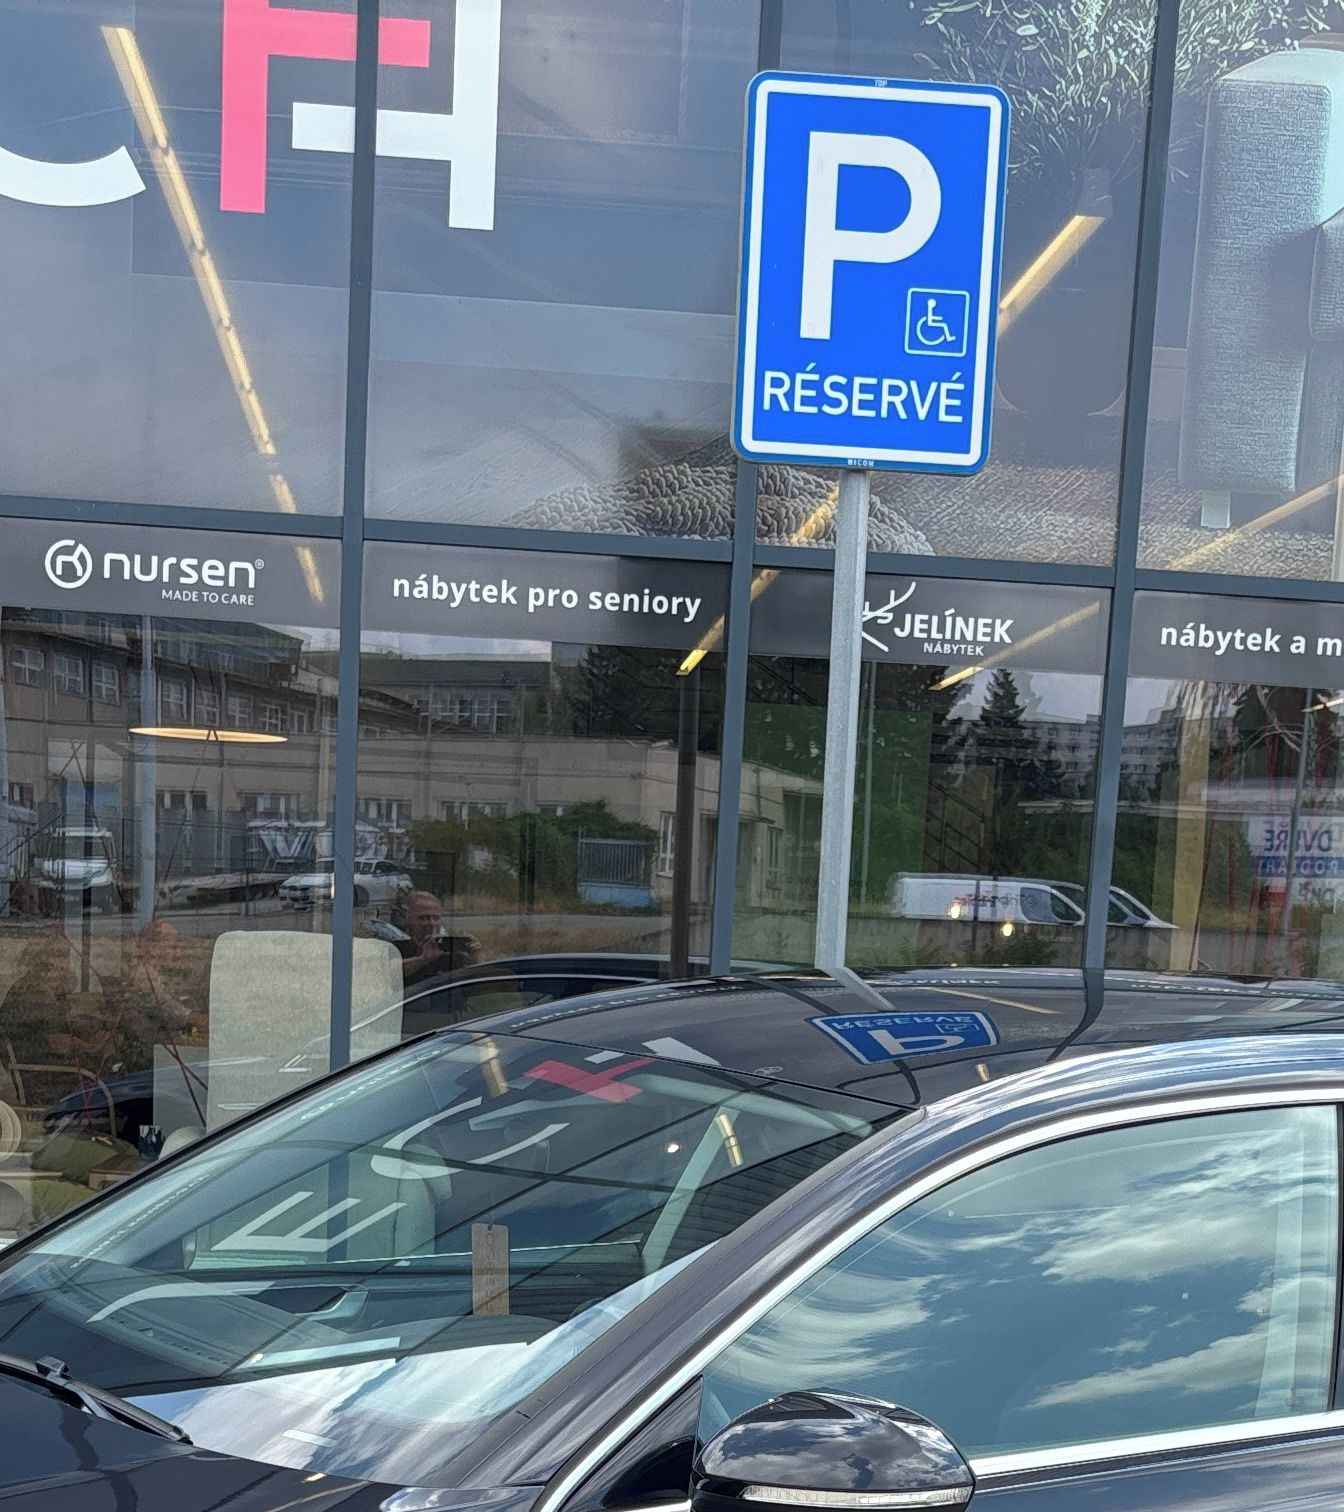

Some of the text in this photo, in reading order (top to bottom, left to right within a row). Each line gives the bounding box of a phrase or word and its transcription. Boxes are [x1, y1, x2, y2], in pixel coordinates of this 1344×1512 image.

[800, 132, 941, 339] P
[763, 364, 964, 423] RÉSERVÉ
[161, 588, 255, 606] MADE TO CARE
[393, 573, 702, 623] nábytek pro seniory
[893, 606, 1014, 645] JELÍNEK
[1160, 622, 1281, 656] nábytek
[1290, 635, 1306, 654] a
[922, 640, 985, 657] NÁBYTEK
